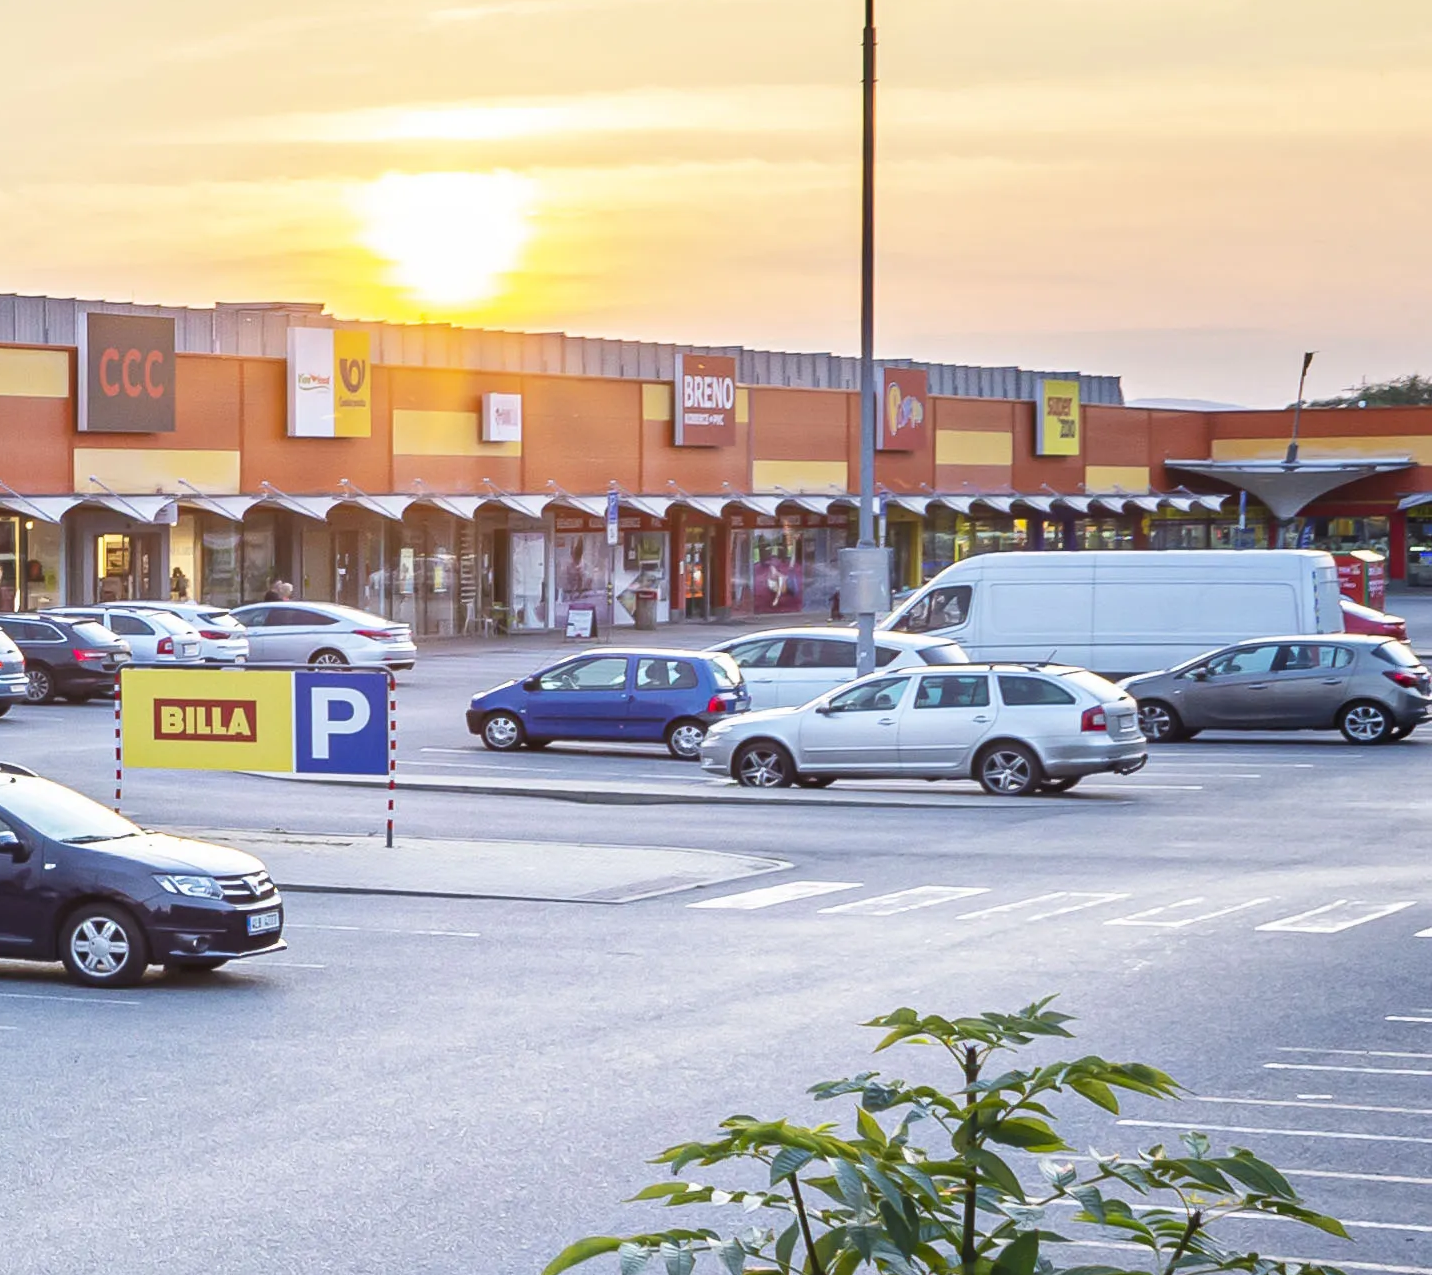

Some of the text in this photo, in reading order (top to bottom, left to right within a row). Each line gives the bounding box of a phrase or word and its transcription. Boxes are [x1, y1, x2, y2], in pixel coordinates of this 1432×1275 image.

[98, 347, 166, 399] CCC
[684, 375, 734, 410] BRENO
[160, 705, 252, 736] BILLA
[311, 686, 371, 760] P
